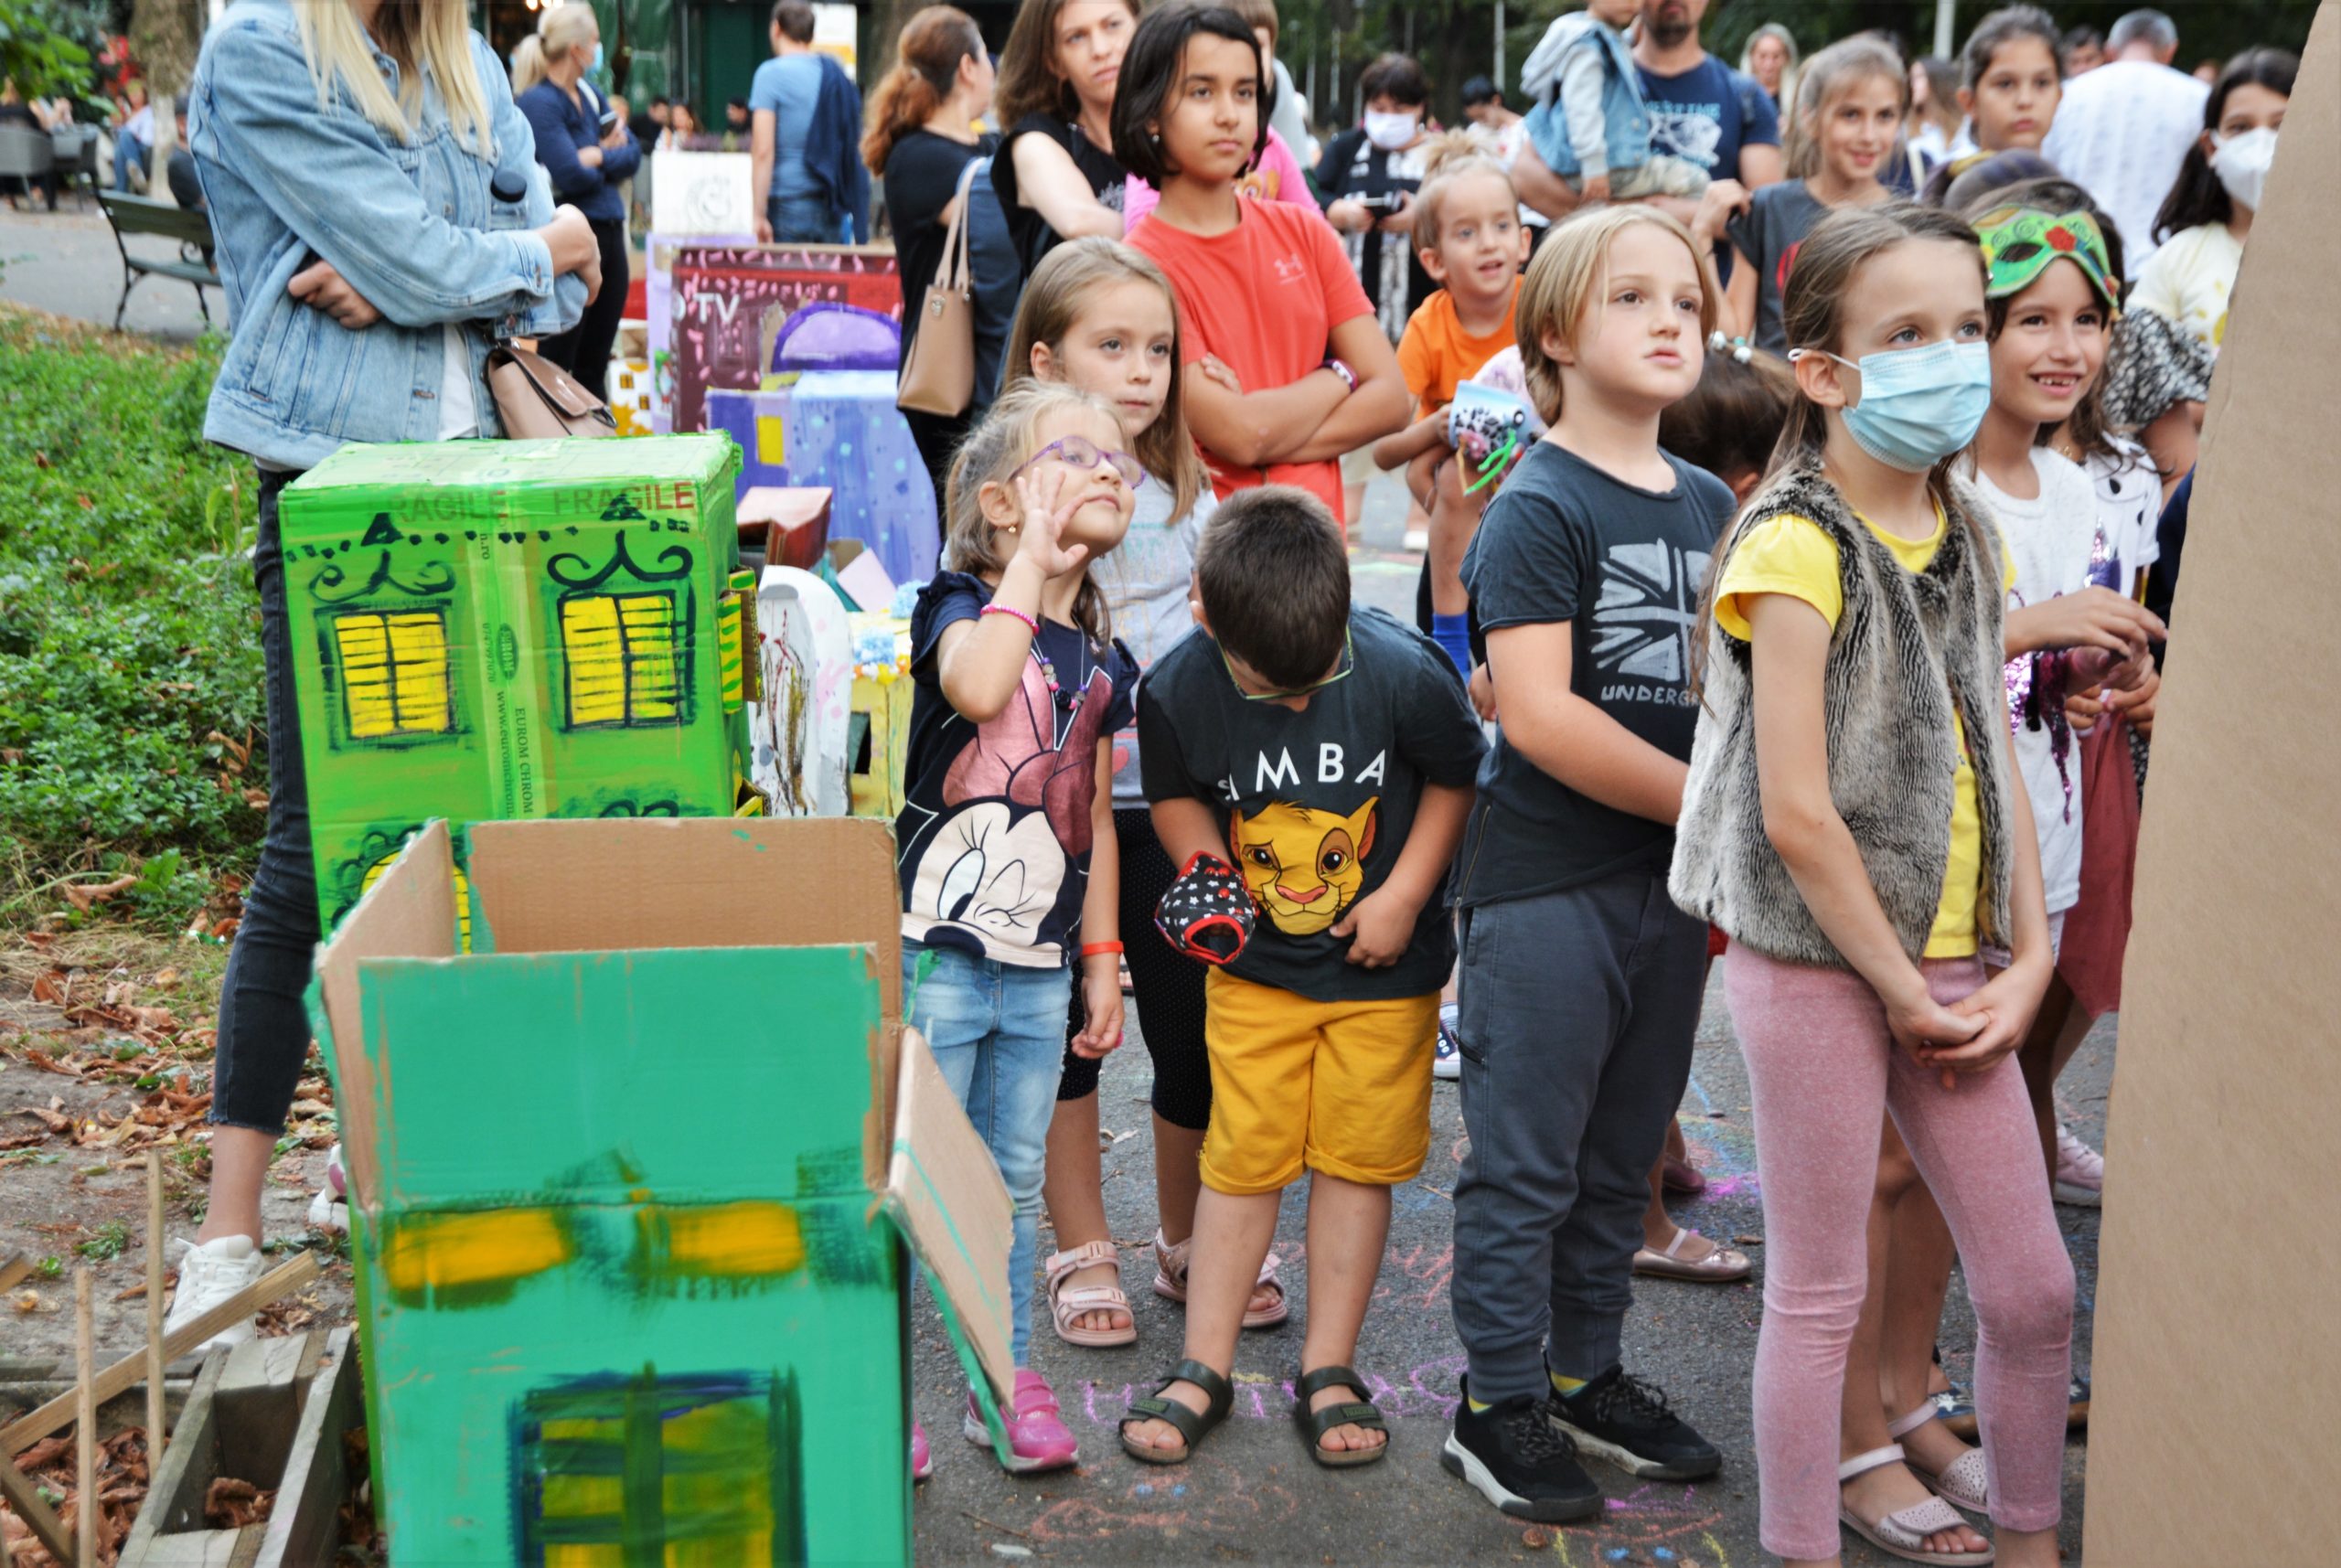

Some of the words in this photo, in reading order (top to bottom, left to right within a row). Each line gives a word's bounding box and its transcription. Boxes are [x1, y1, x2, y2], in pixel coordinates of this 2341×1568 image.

[692, 292, 742, 325] TV
[515, 708, 528, 759] EUROM
[520, 762, 534, 814] CHROM
